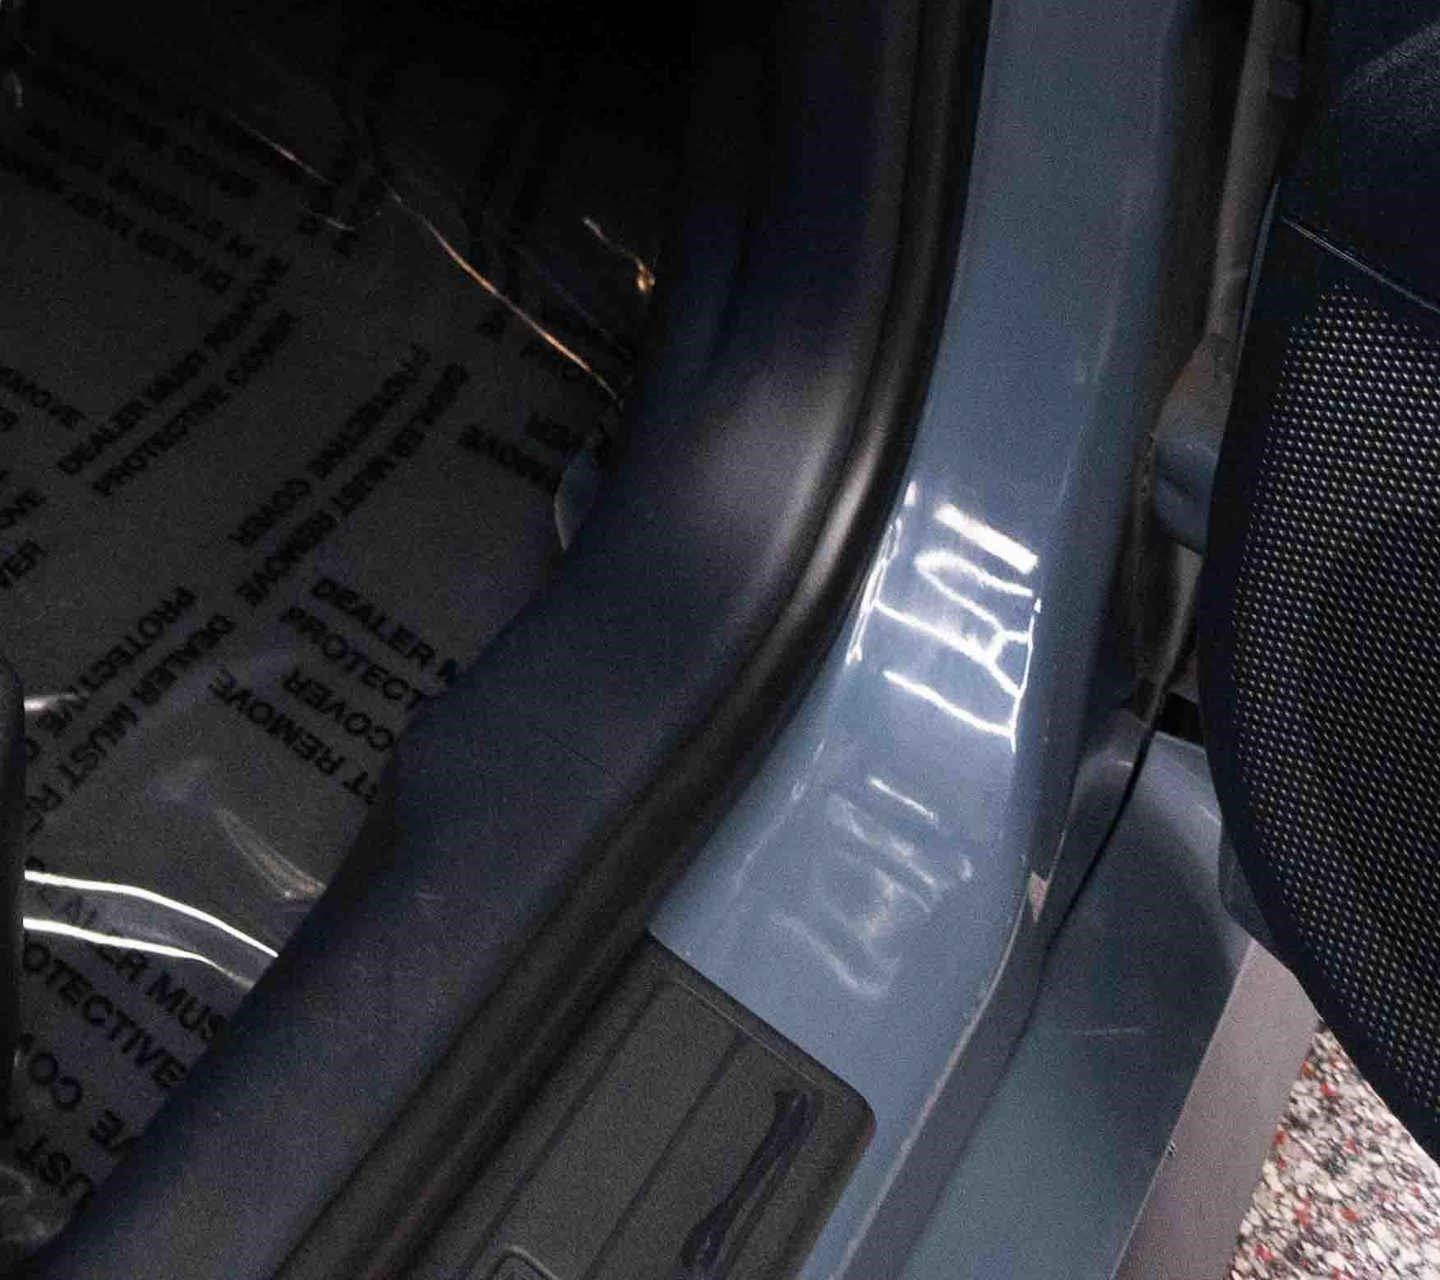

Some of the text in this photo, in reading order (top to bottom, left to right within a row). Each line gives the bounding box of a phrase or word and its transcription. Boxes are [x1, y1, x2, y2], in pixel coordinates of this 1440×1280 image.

[37, 585, 199, 739] PROTECTIVE
[310, 575, 439, 670] DEALER
[55, 612, 237, 794] DEALER MUST
[207, 664, 347, 778] REMOVE
[281, 664, 397, 752] COVER
